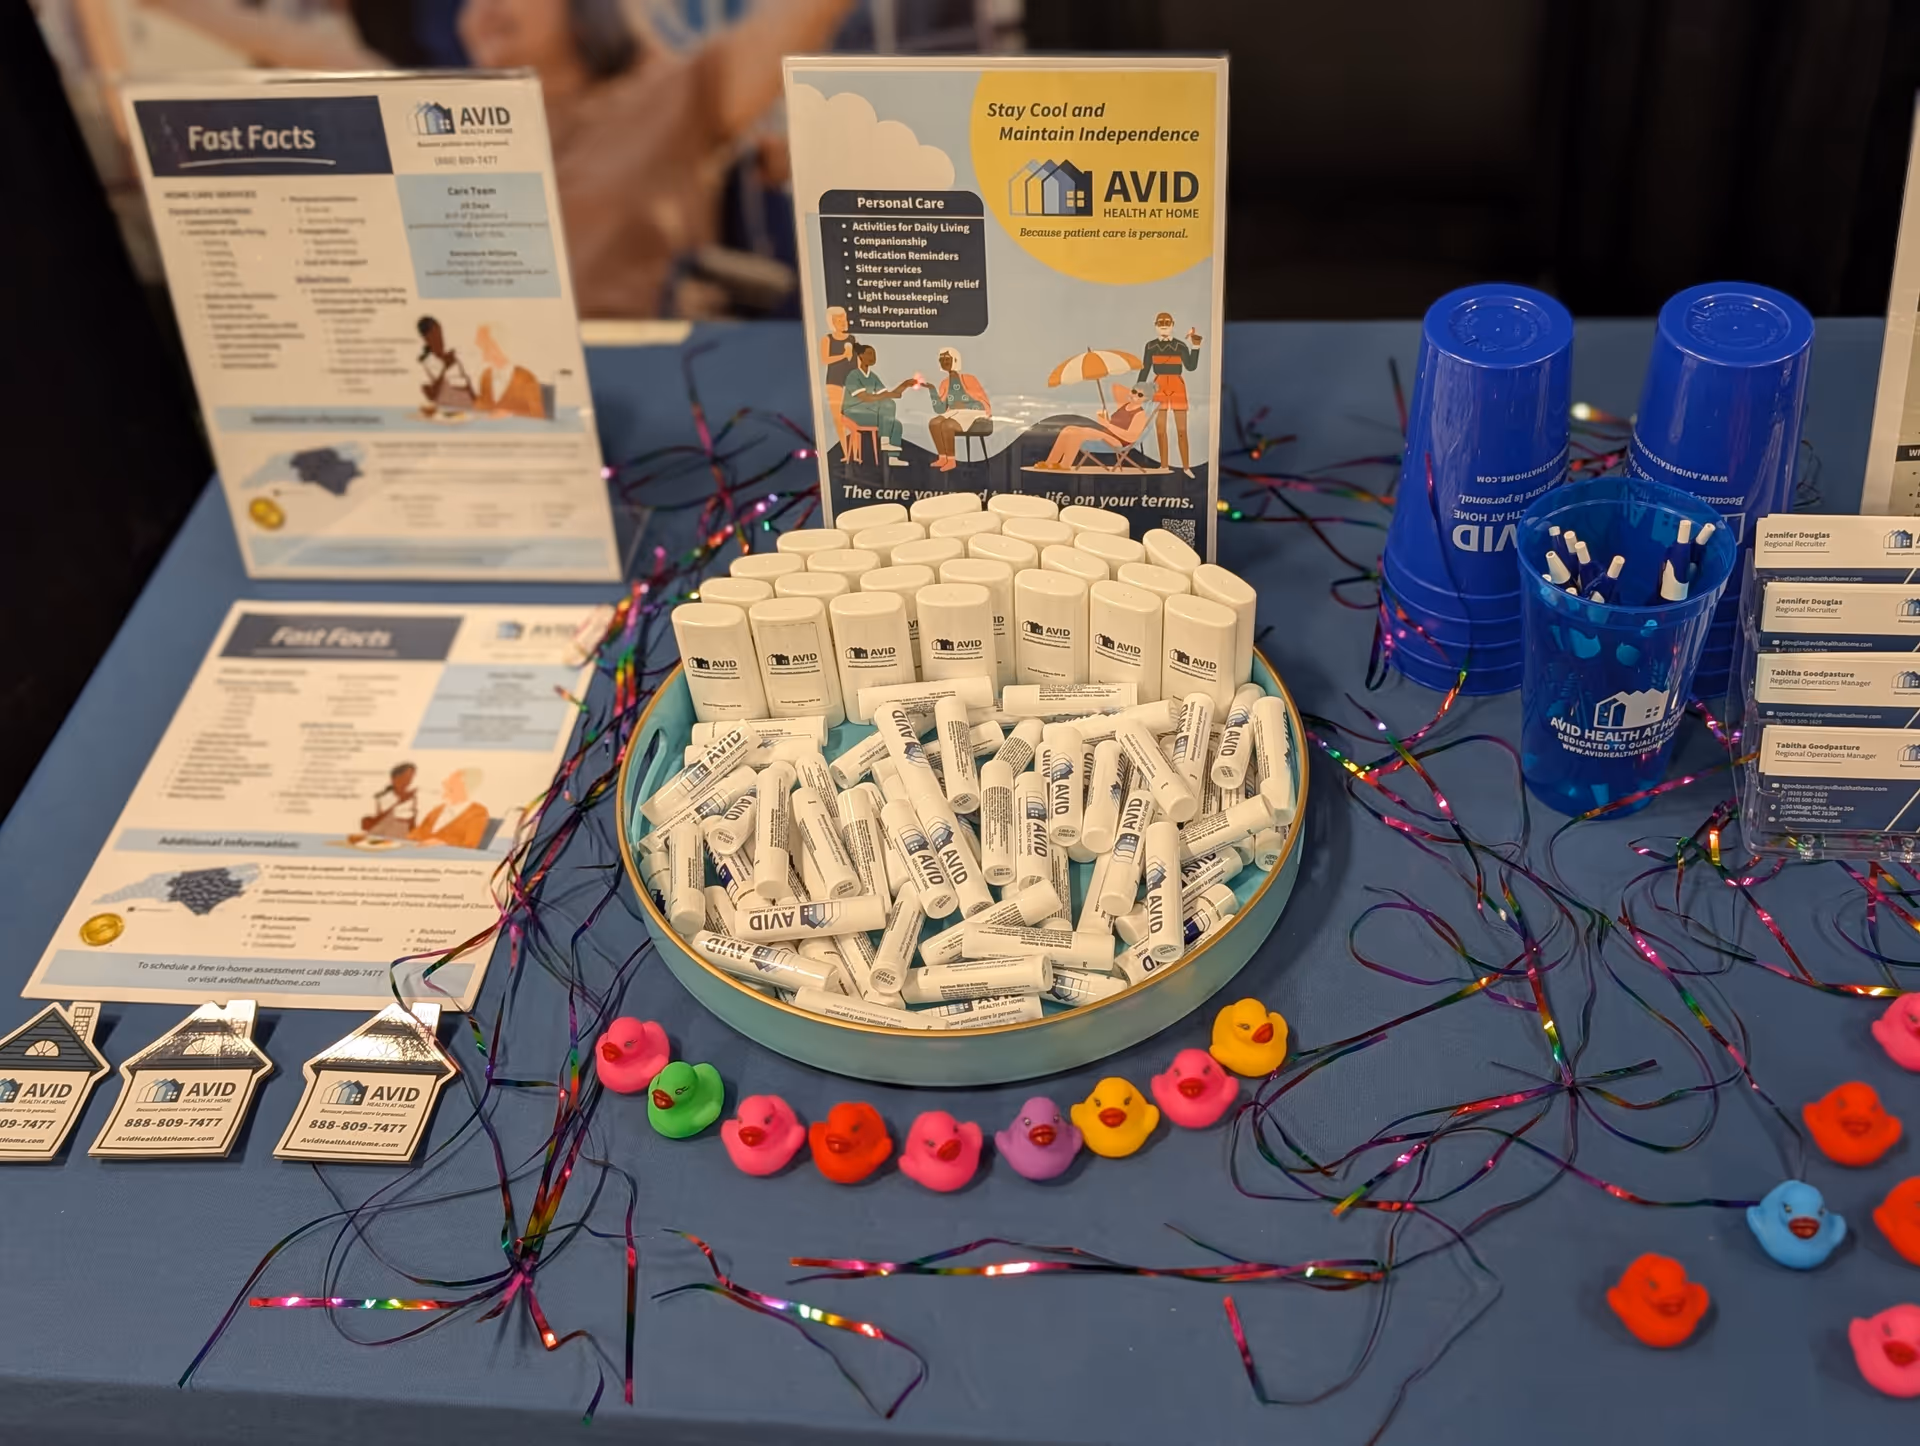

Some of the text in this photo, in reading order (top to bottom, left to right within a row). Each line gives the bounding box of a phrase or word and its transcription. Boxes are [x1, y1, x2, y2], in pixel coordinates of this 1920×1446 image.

[460, 106, 511, 126] AVID
[987, 102, 1105, 120] Stay Cool and
[188, 125, 316, 151] Fast Facts
[999, 126, 1200, 145] Maintain Independence
[1104, 170, 1199, 203] AVID
[857, 196, 945, 210] Personal Care
[1103, 208, 1199, 218] HEALTH AT HOME
[852, 221, 970, 235] Activities for Daily Living
[1019, 228, 1189, 241] Because patient care is personal.
[853, 235, 928, 248] Companionship
[854, 249, 959, 262] Medication Reminders
[855, 263, 922, 274] Sitter services
[857, 278, 979, 291] Caregiver and family relief
[858, 291, 949, 305] Light housekeeping
[859, 305, 937, 317] Meal Preparation
[860, 318, 929, 330] Transportation
[842, 485, 872, 500] The
[876, 489, 911, 501] care
[1045, 491, 1070, 506] life
[1074, 495, 1095, 507] on
[1099, 495, 1137, 509] your
[1141, 494, 1195, 510] terms.
[1514, 494, 1524, 504] is
[1453, 510, 1487, 522] HOME
[1490, 513, 1504, 522] AT
[1452, 523, 1518, 553] VID
[1764, 532, 1830, 540] Jennifer Douglas
[1776, 597, 1843, 606] Jennifer Douglas
[1775, 606, 1805, 614] Regional
[270, 626, 392, 648] Fast Facts
[1046, 626, 1071, 637] AVID
[870, 646, 896, 656] AVID
[956, 639, 982, 649] AVID
[1117, 642, 1141, 655] AVID
[711, 659, 737, 669] AVID
[792, 653, 818, 663] AVID
[1192, 657, 1217, 671] AVID
[1771, 669, 1855, 679] Tabitha Goodpasture
[1769, 678, 1871, 687] Regional Operations Manager
[892, 709, 916, 738] AVID
[1550, 716, 1660, 742] AVID HEALTH AT
[706, 730, 742, 765] AVID
[1220, 730, 1241, 756] AVID
[1557, 732, 1610, 750] DEDICATED
[1628, 733, 1664, 750] QUALITY
[1808, 743, 1860, 751] Goodpasture
[1846, 751, 1877, 760] Manager
[1054, 784, 1070, 815] AVID
[724, 798, 752, 820] AVID
[1122, 797, 1143, 830] AVID
[158, 836, 222, 848] Additional
[1033, 822, 1047, 857] AVID
[917, 854, 944, 885] AVID
[942, 849, 968, 885] AVID
[1182, 852, 1217, 878] AVID
[749, 911, 795, 931] AVID
[1149, 895, 1163, 934] AVID
[705, 937, 750, 960] AVID
[138, 961, 148, 969] To
[150, 962, 189, 971] schedule
[197, 964, 216, 972] free
[216, 964, 253, 973] in-home
[254, 966, 305, 975] assessment
[306, 967, 324, 976] call
[324, 968, 384, 977] 888-809-7477
[218, 976, 321, 986] avidhealthathome.com
[978, 1002, 1000, 1011] HEALTH
[1009, 997, 1026, 1005] HOME
[22, 1083, 72, 1098] AVID
[185, 1082, 237, 1097] AVID
[369, 1086, 421, 1102] AVID
[124, 1118, 223, 1128] 888-809-7477
[308, 1119, 408, 1133] 888-809-7477
[300, 1137, 399, 1148] AvidHealthAtHome.com
